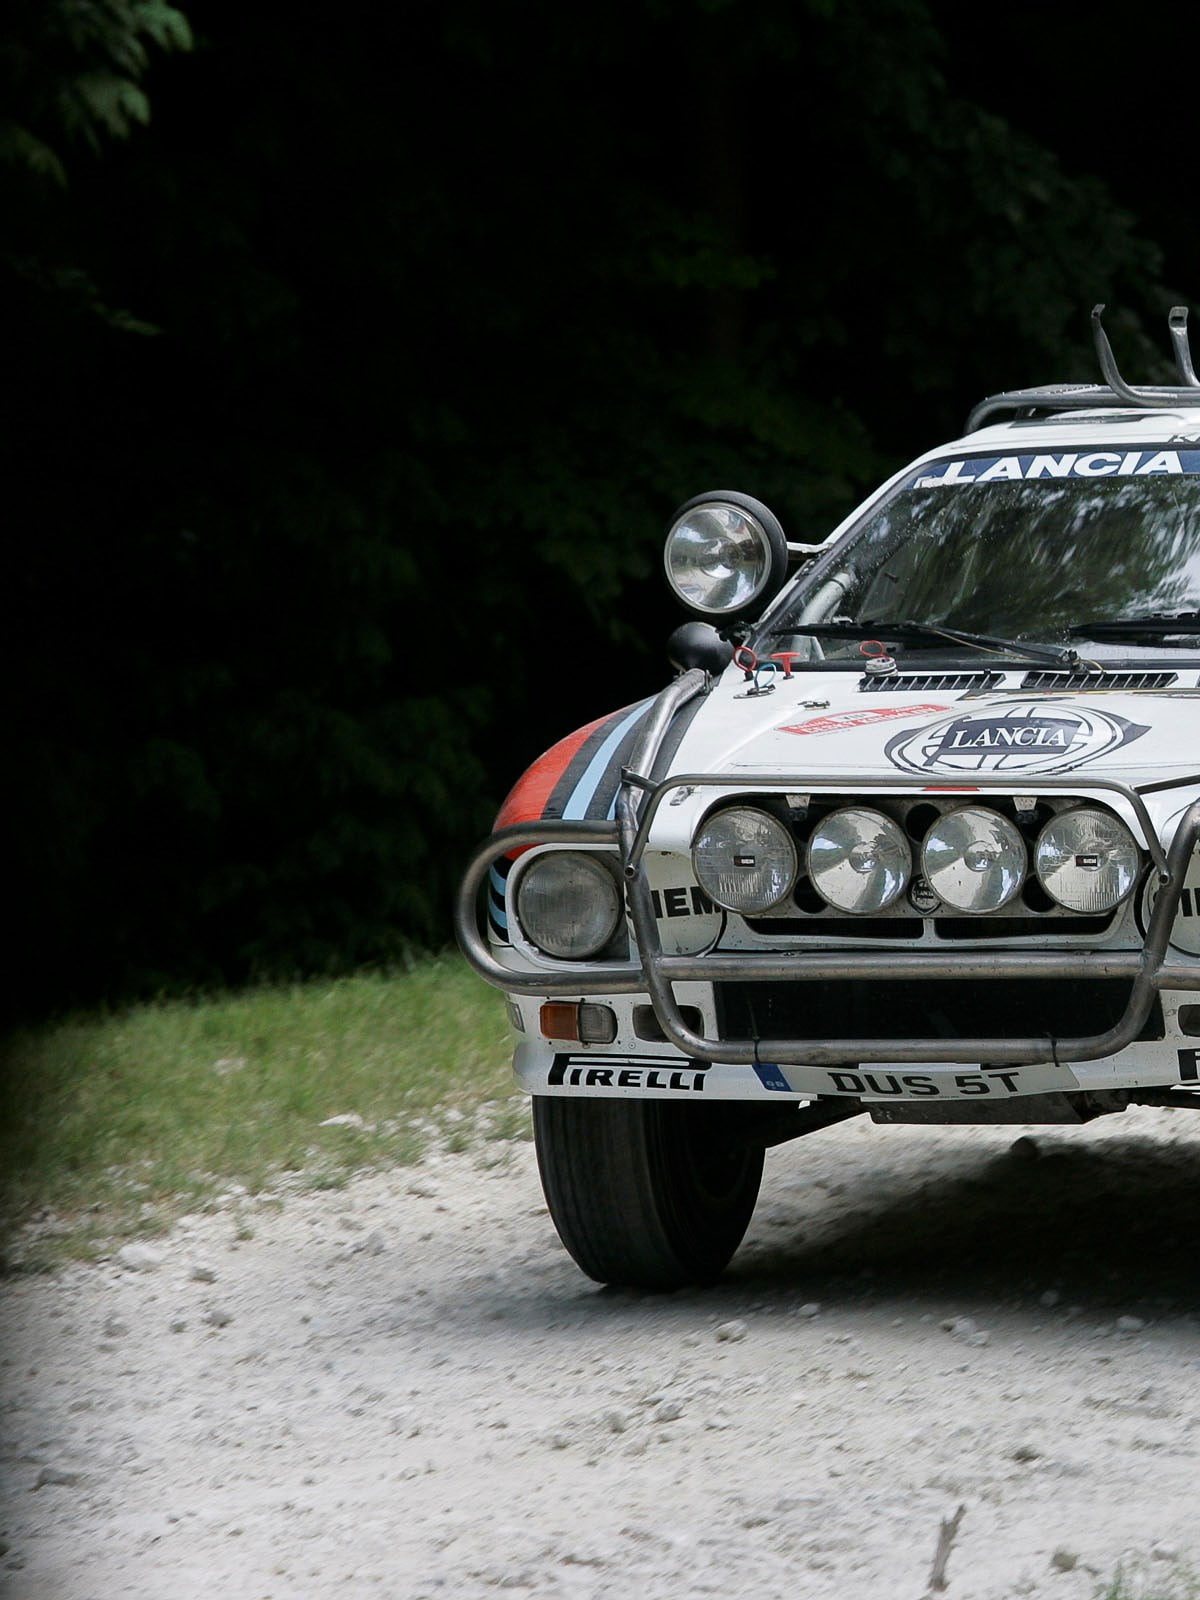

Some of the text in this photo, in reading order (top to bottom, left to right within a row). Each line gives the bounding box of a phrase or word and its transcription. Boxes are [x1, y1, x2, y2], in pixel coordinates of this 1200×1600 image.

[940, 451, 1184, 484] LANCIA
[949, 726, 1067, 749] LANCIA
[625, 886, 722, 919] IEM
[548, 1053, 712, 1091] PIRELLI
[827, 1072, 940, 1096] DUS
[955, 1071, 1020, 1095] 5T
